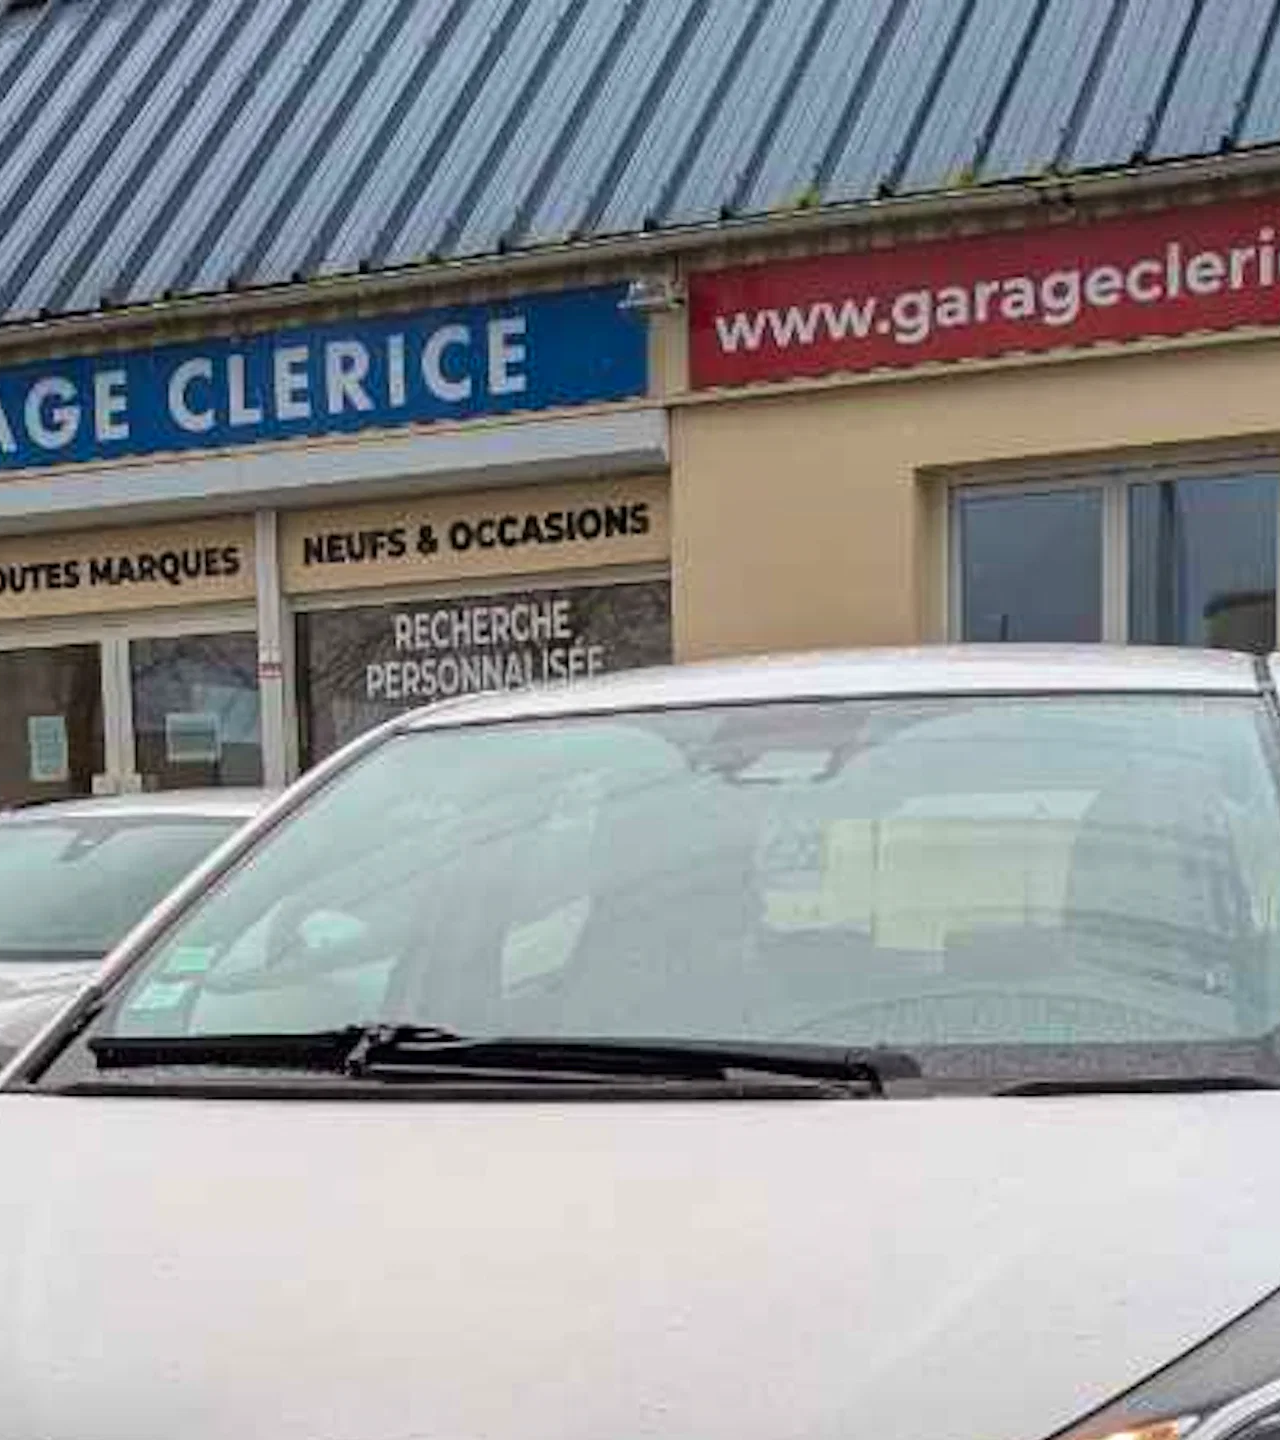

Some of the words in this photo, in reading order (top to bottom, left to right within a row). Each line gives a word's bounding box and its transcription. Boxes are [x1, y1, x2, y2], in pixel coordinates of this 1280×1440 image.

[167, 315, 527, 433] CLERICE
[303, 528, 407, 566] NEUFS
[416, 524, 438, 555] &
[449, 502, 651, 552] OCCASIONS
[89, 546, 242, 586] MARQUES
[394, 600, 572, 652] RECHERCHE
